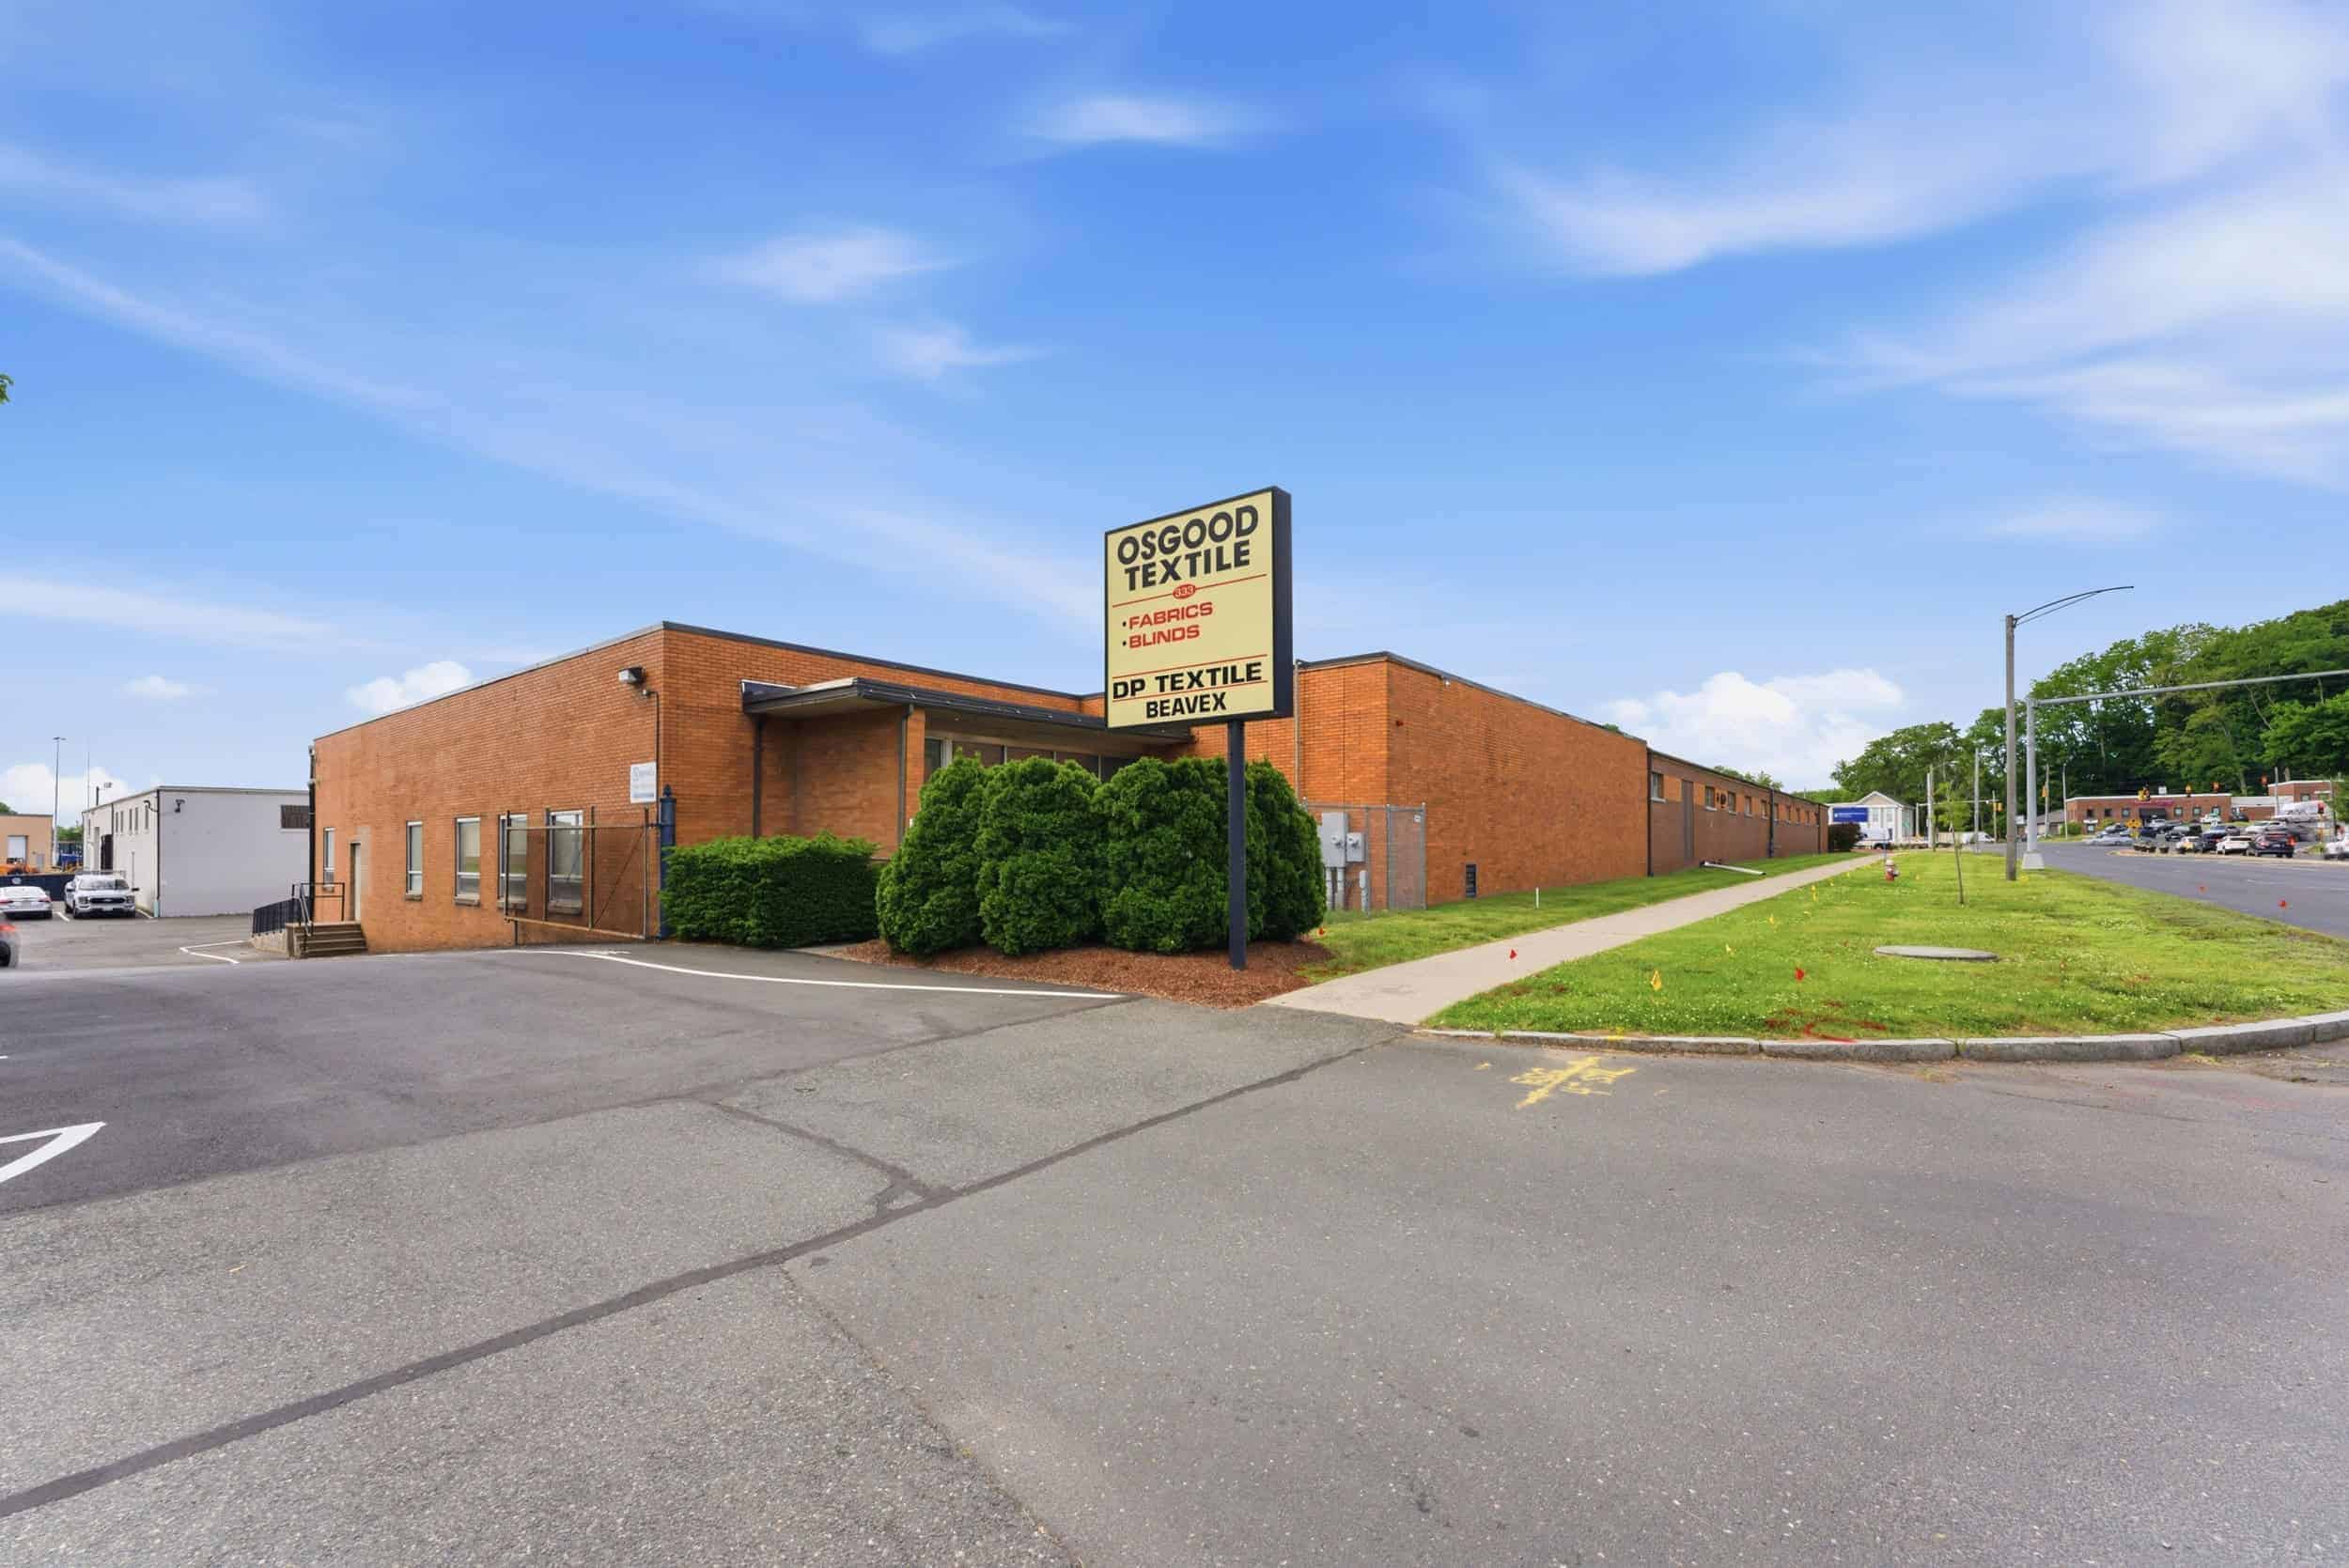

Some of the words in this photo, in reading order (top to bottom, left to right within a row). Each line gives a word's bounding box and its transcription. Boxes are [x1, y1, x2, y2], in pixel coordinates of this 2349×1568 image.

[1117, 505, 1258, 566] OSGOOD
[1125, 539, 1250, 591] TEXTILE
[1129, 601, 1213, 629] FABRICS
[1129, 624, 1200, 649] BLINDS
[1112, 678, 1145, 699] DP
[1155, 661, 1262, 693] TEXTILE
[1145, 691, 1227, 719] BEAVEX
